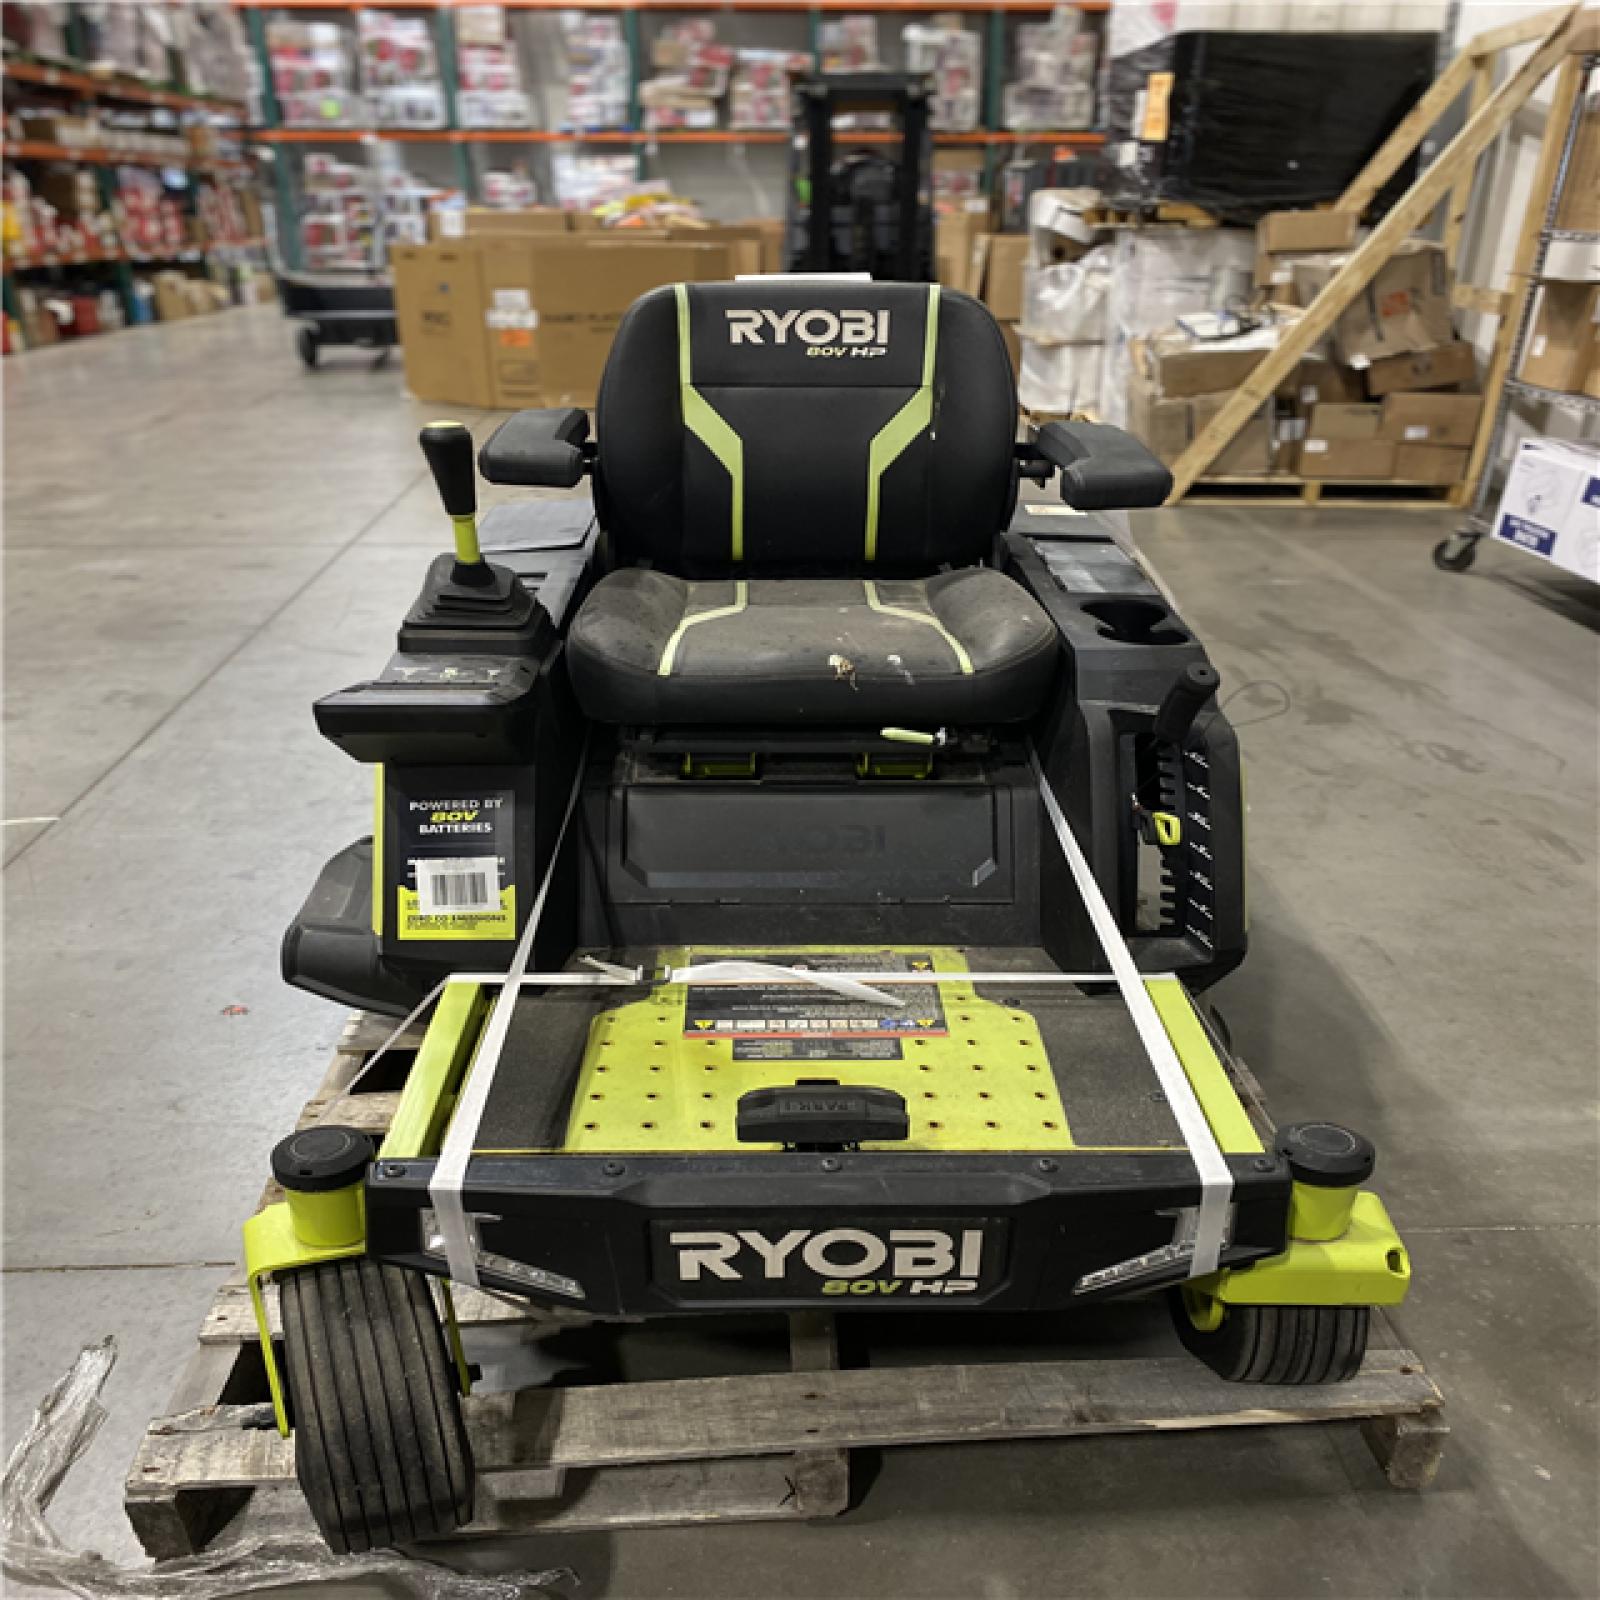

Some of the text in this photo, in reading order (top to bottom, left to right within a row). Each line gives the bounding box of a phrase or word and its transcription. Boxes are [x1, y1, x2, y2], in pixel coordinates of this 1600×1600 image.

[725, 309, 891, 345] RYOBI
[806, 346, 887, 357] 80V HP
[409, 798, 503, 811] POWERED BY
[430, 810, 479, 822] 80V
[419, 822, 493, 834] BATTERIES
[669, 1228, 983, 1280] RYOBI
[823, 1280, 978, 1295] 80V HP
